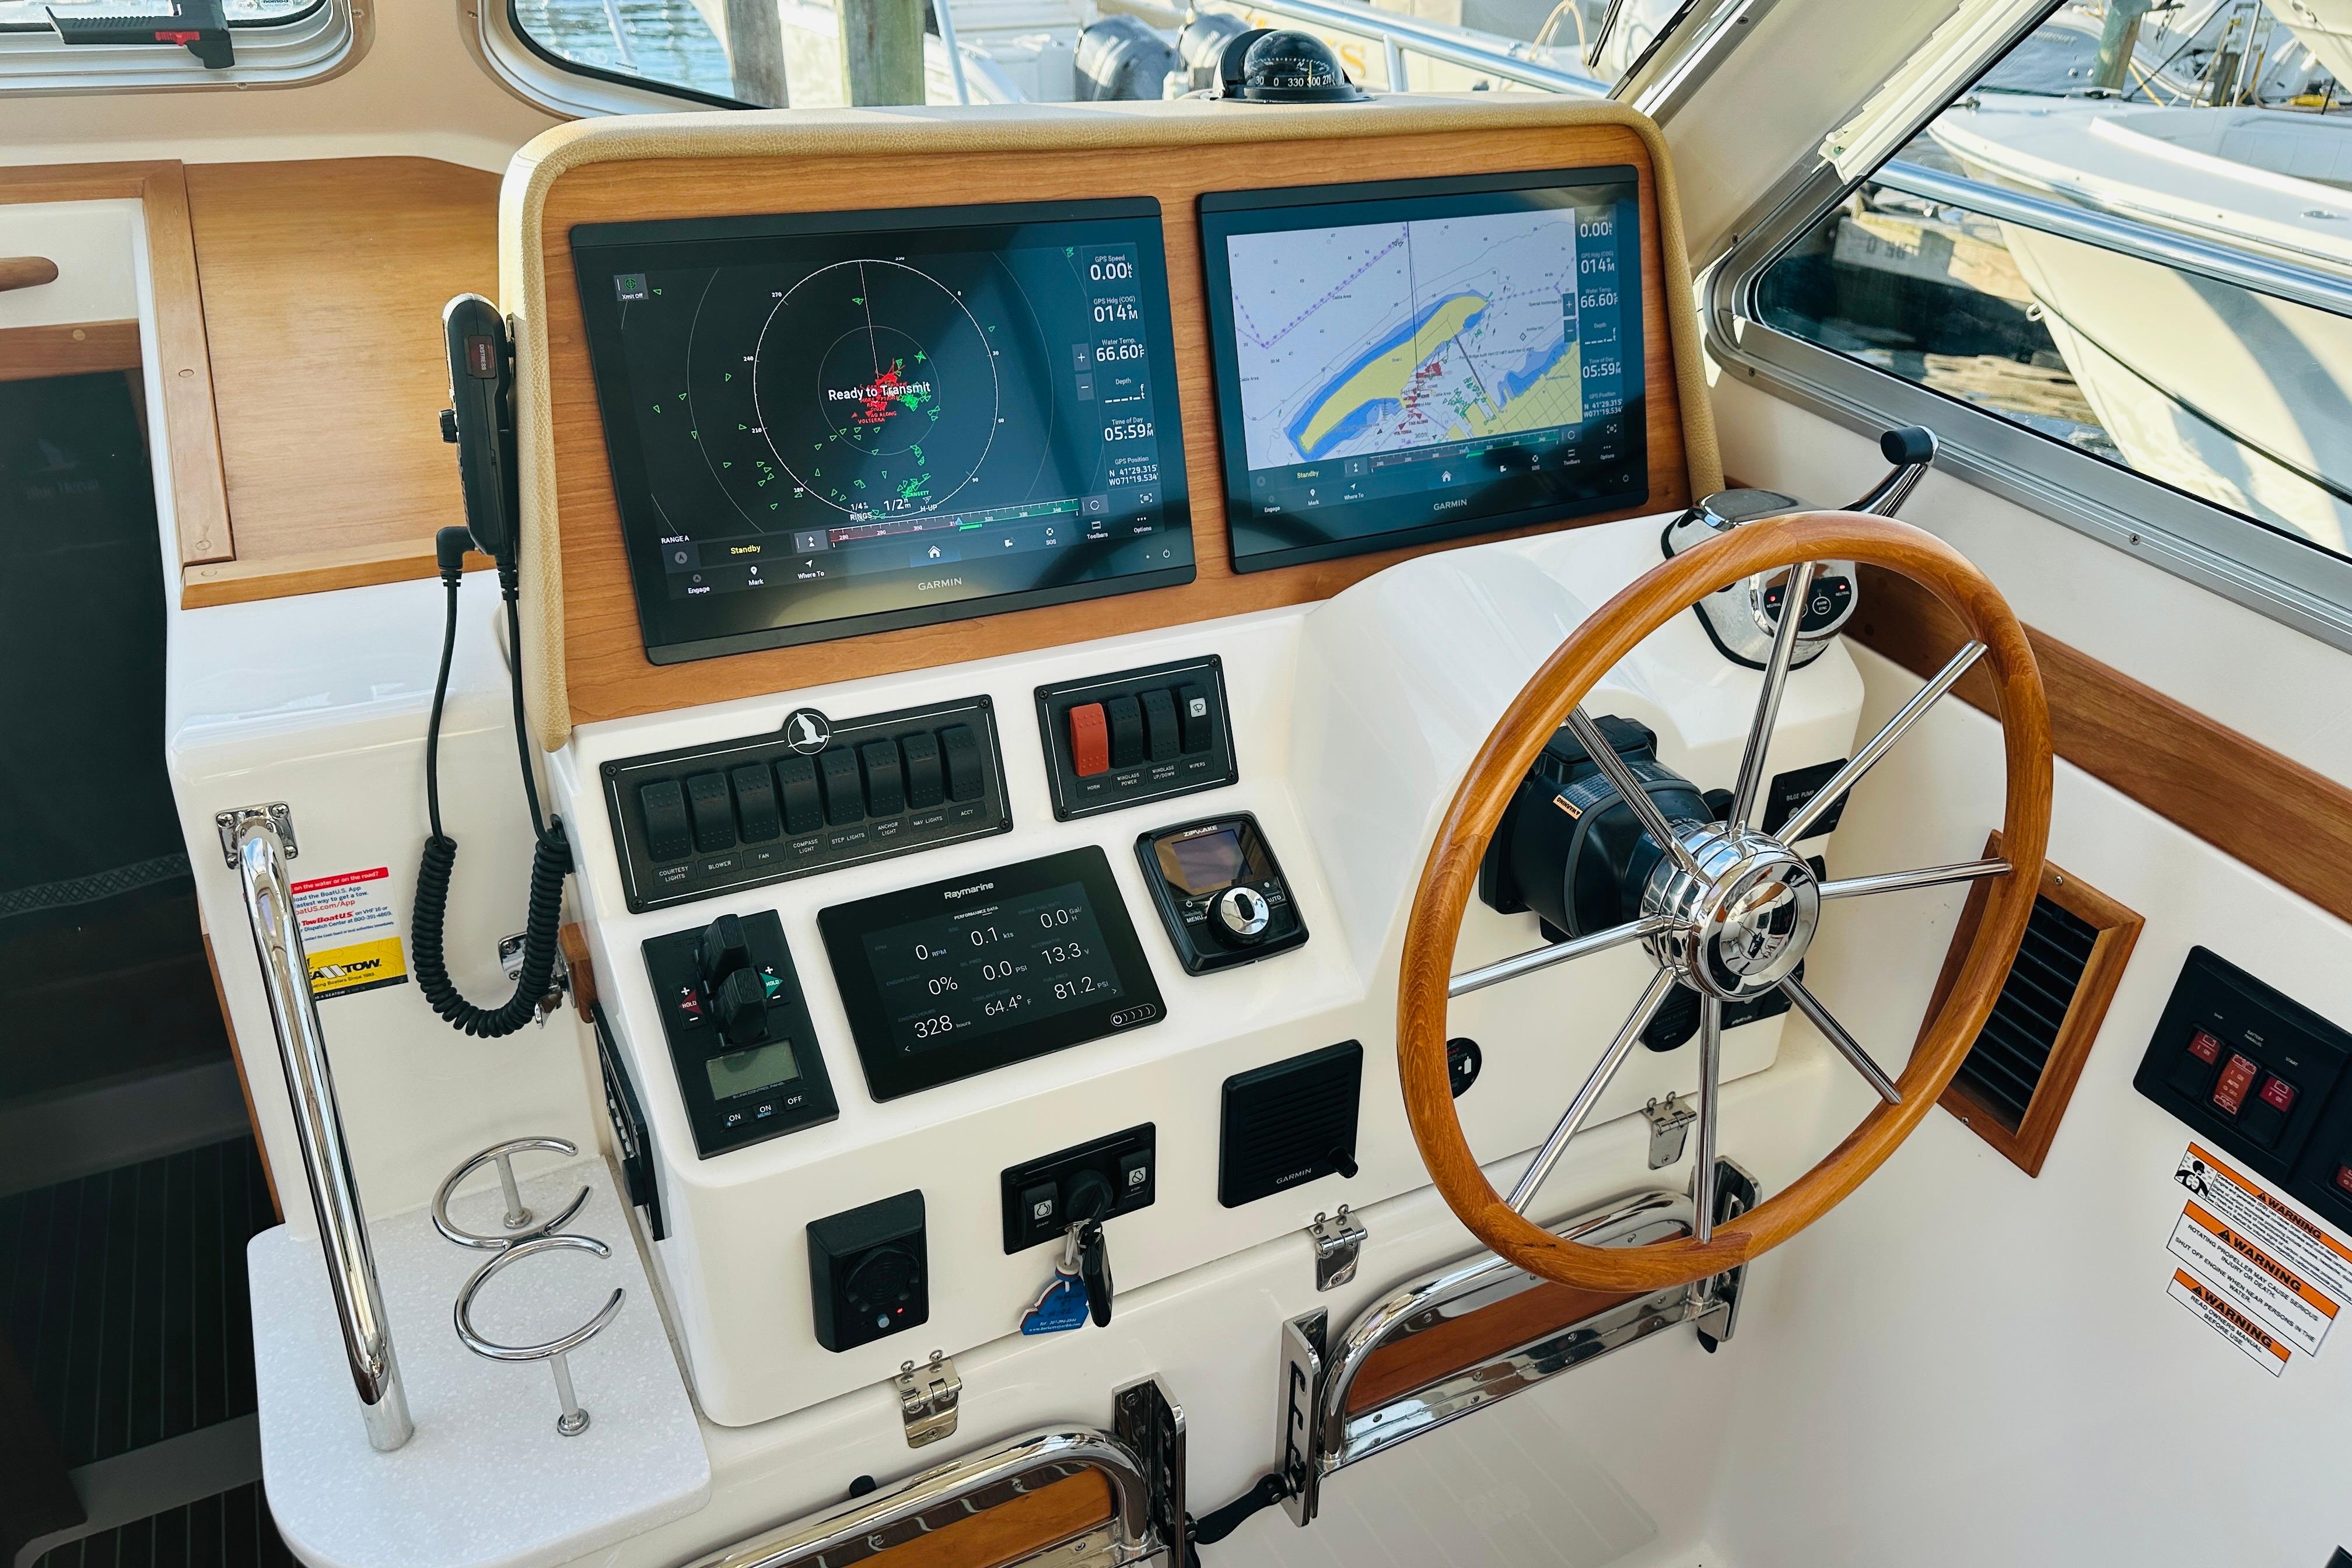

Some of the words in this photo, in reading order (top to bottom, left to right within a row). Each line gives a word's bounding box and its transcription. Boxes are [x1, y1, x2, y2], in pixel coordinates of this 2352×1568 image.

[1255, 76, 1264, 85] 30
[1274, 78, 1279, 86] 0
[1288, 78, 1304, 86] 330
[828, 387, 863, 401] Ready
[866, 387, 878, 398] to
[880, 381, 931, 397] Transmit
[1297, 470, 1319, 479] Standby
[1434, 499, 1467, 510] GARMIN
[730, 545, 761, 554] Standby
[688, 586, 710, 594] Engage
[918, 577, 963, 592] GARMIN
[1152, 765, 1174, 774] WINDLASS
[1189, 761, 1206, 769] WIPERS
[1117, 772, 1140, 781] WINDLASS
[1153, 771, 1175, 779] UP/DOWN
[877, 821, 898, 831] ANCHOR
[1183, 825, 1218, 837] ZIPWAKE
[846, 832, 865, 841] LIGHTS
[793, 839, 818, 848] COMPASS
[708, 860, 732, 870] BLOWER
[659, 866, 689, 877] COURTESY
[665, 873, 685, 882] LIGHTS
[944, 882, 994, 900] Raymarine
[954, 908, 987, 920] PERFORMANCE
[1040, 909, 1069, 929] 0.0
[1186, 915, 1203, 923] MENU
[304, 924, 327, 932] Dispatch
[970, 927, 998, 946] 0.1
[915, 944, 928, 960] 0
[932, 949, 947, 957] RPM
[1041, 943, 1082, 965] 13.3
[983, 961, 1012, 981] 0.0
[1015, 965, 1027, 973] PSI
[765, 978, 779, 986] HOLD
[928, 977, 958, 995] 0%
[1054, 976, 1096, 999] 81.2
[1097, 981, 1109, 989] PSI
[681, 999, 697, 1009] HOLD
[915, 1015, 953, 1038] 328
[956, 1020, 971, 1028] hours
[788, 1096, 803, 1105] OFF
[760, 1104, 772, 1113] ON
[729, 1114, 741, 1122] ON
[1276, 1167, 1312, 1185] GARMIN
[2269, 1198, 2322, 1240] WARNING
[2221, 1256, 2243, 1273] INJURY
[2244, 1273, 2253, 1282] OR
[2234, 1237, 2302, 1292] WARNING
[2188, 1224, 2216, 1247] ROTATING
[2217, 1245, 2252, 1273] PROPELLER
[2253, 1272, 2267, 1283] MAY
[2268, 1283, 2290, 1300] CAUSE
[2290, 1298, 2319, 1321] SERIOUS
[2175, 1237, 2192, 1250] SHUT
[2192, 1250, 2204, 1259] OFF
[2204, 1258, 2227, 1277] ENGINE
[2227, 1275, 2245, 1291] WHEN
[2246, 1289, 2263, 1304] NEAR
[2263, 1302, 2294, 1326] PERSONS
[2302, 1330, 2315, 1343] THE
[2190, 1296, 2208, 1310] READ
[2208, 1309, 2235, 1331] OWNERS
[2236, 1330, 2262, 1353] MANUAL
[2205, 1291, 2272, 1348] WARNING
[2204, 1313, 2229, 1335] BEFORE
[2230, 1333, 2243, 1345] USE
